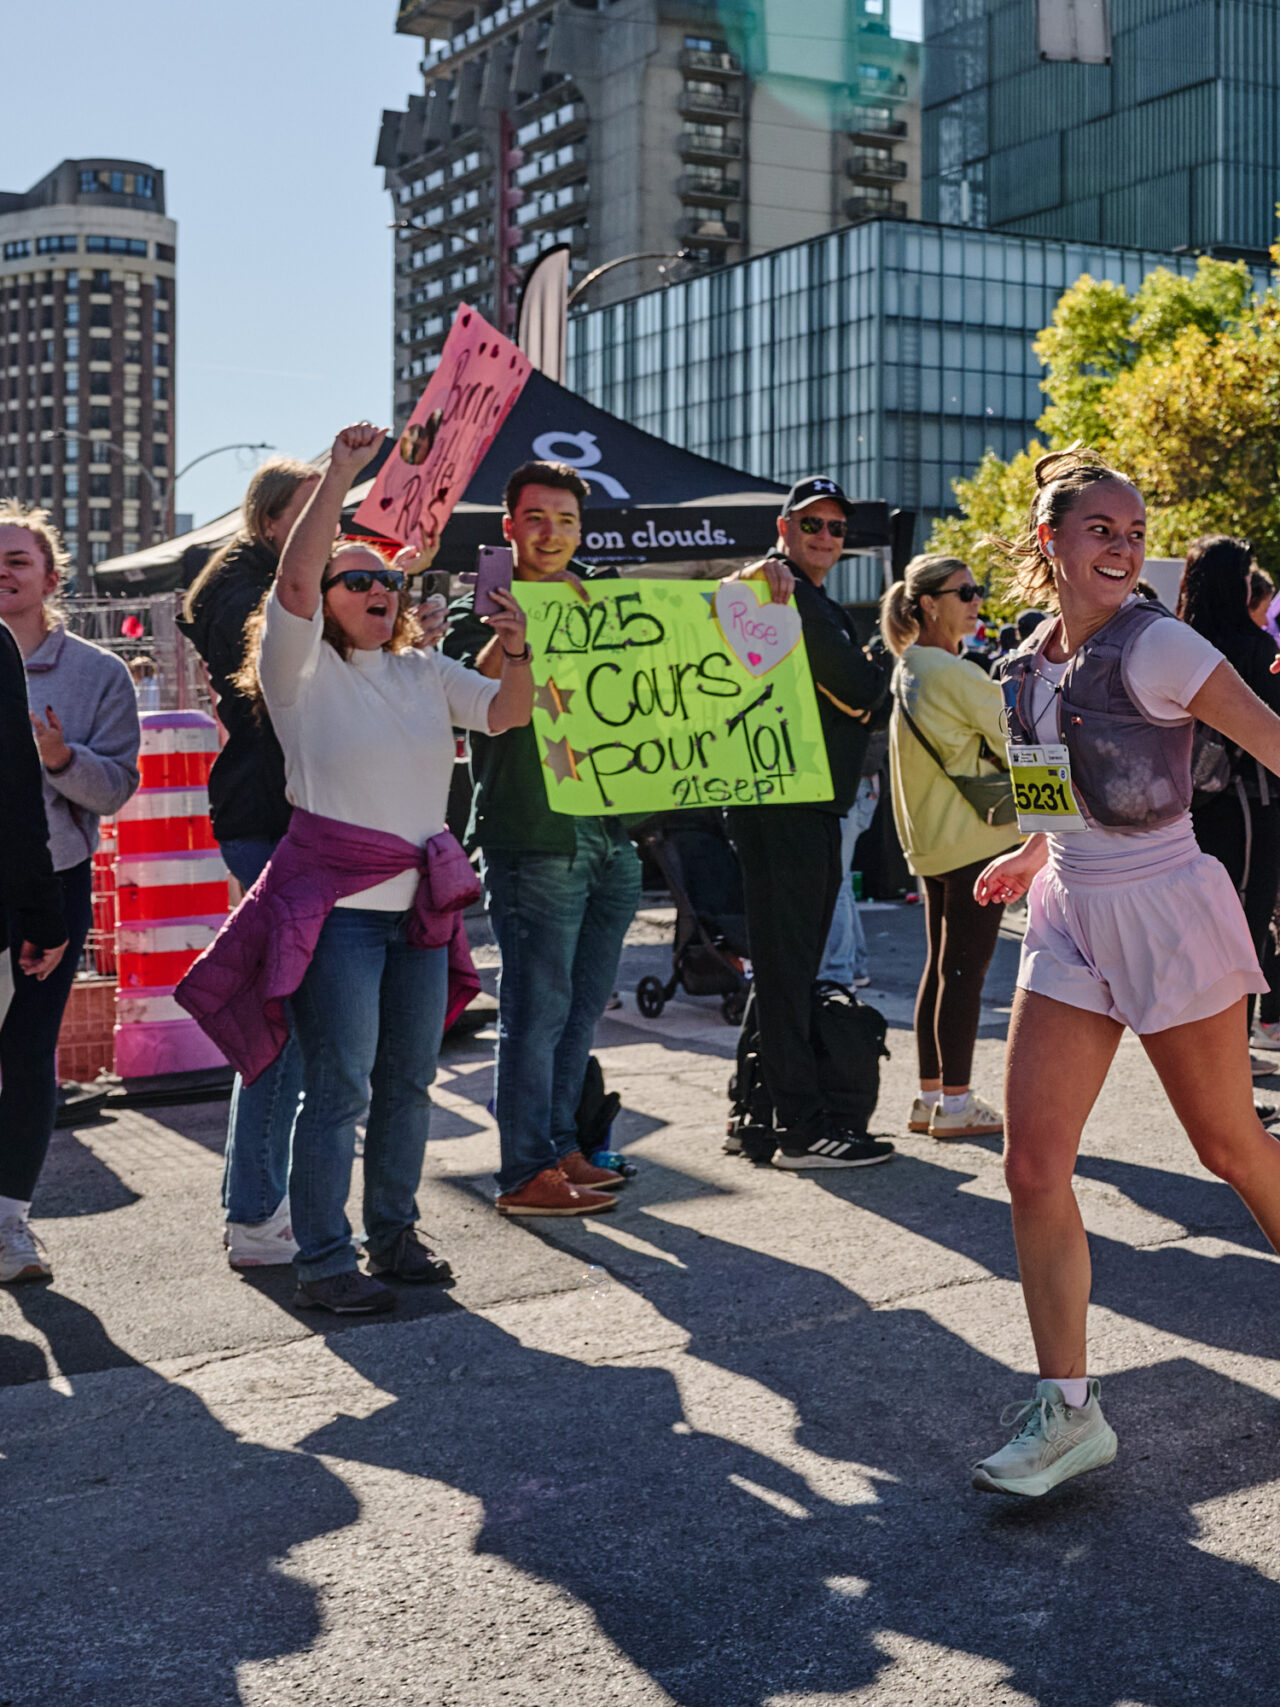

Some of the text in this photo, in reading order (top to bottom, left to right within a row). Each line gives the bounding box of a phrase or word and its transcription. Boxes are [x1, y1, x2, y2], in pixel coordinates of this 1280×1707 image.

[585, 519, 736, 550] on clouds.
[543, 592, 665, 654] 2025
[728, 601, 778, 646] Rose
[586, 652, 742, 727] Cours
[587, 683, 796, 807] pour Toi
[1015, 783, 1070, 811] 5231
